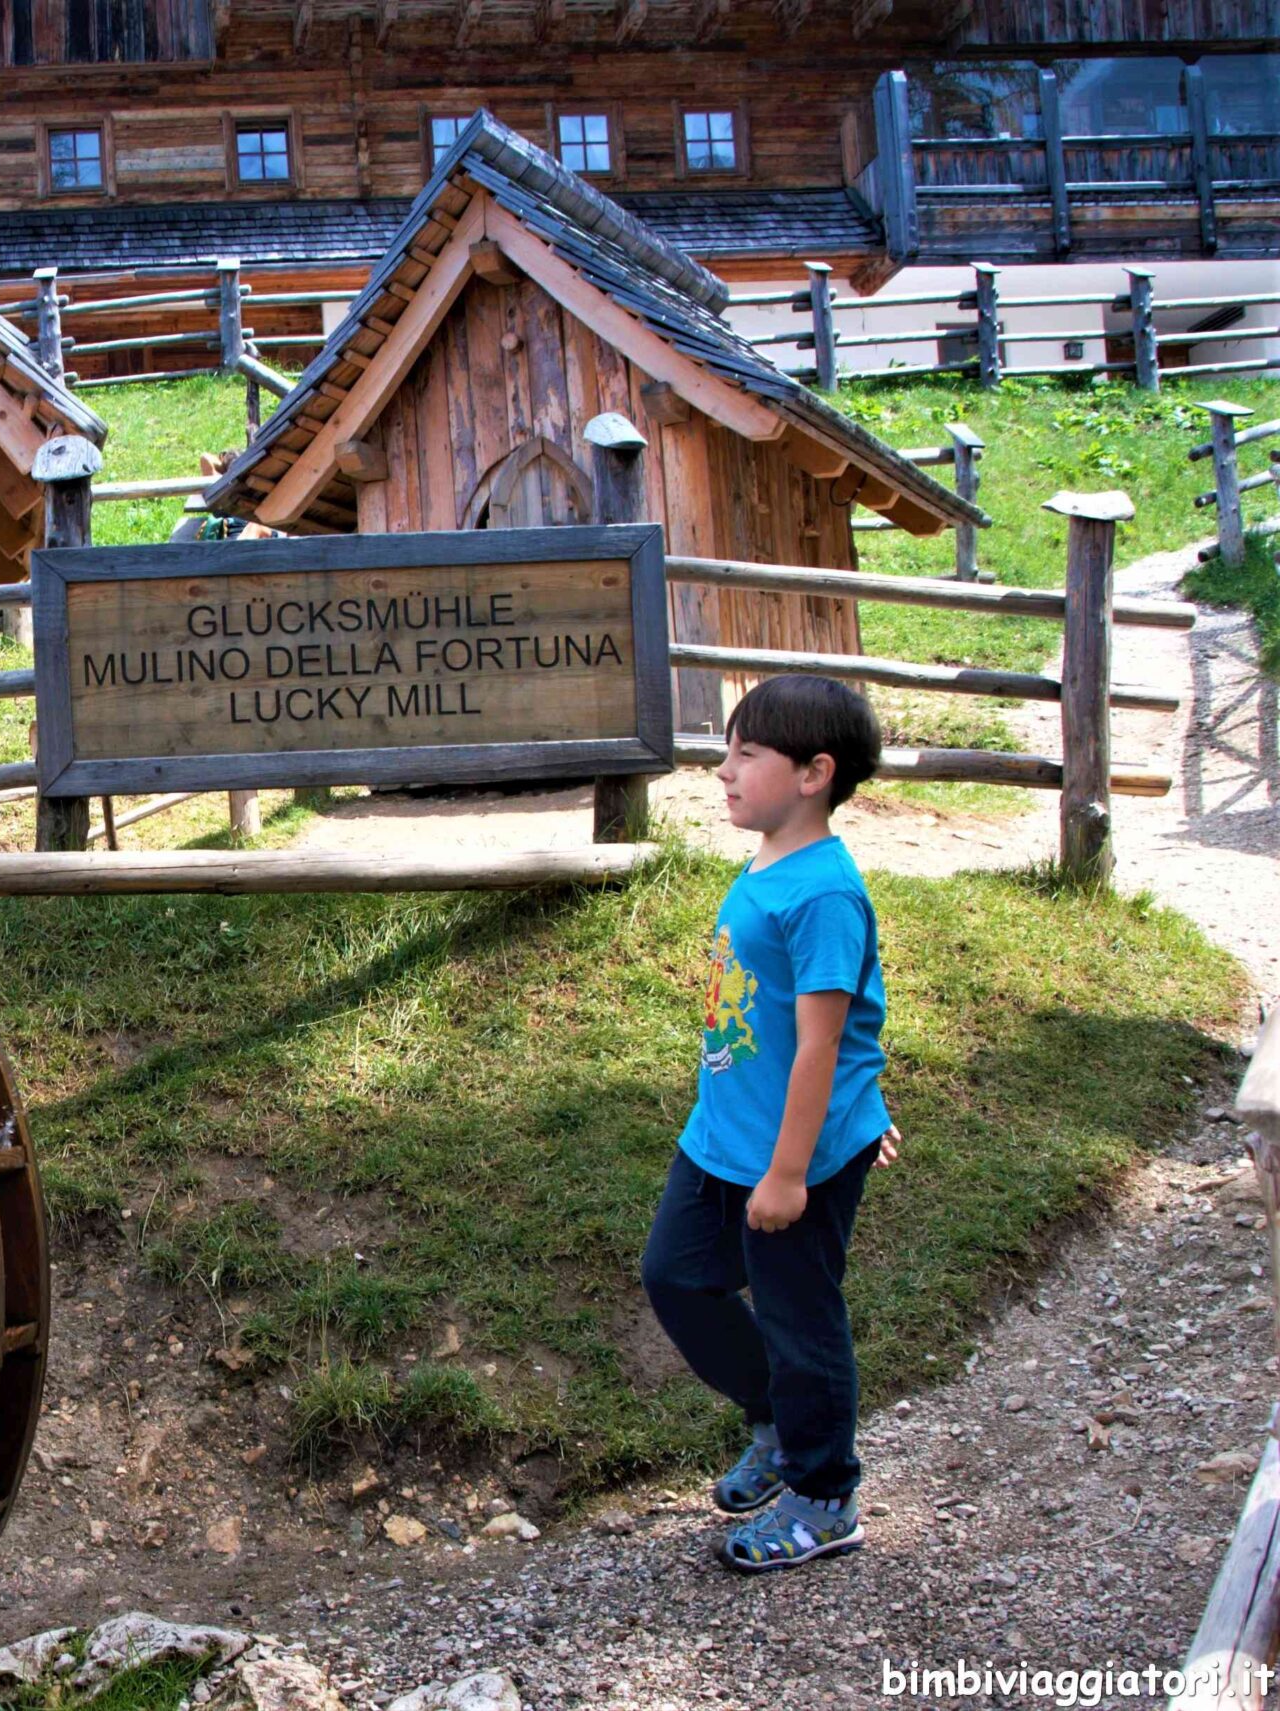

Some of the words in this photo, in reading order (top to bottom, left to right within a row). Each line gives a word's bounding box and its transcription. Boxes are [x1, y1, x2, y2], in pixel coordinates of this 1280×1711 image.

[186, 592, 515, 638] GLÜCKSMÜHLE
[83, 646, 250, 687] MULINO
[266, 641, 402, 679] DELLA
[415, 632, 624, 673] FORTUNA
[230, 684, 374, 725] LUCKY
[386, 682, 482, 719] MILL
